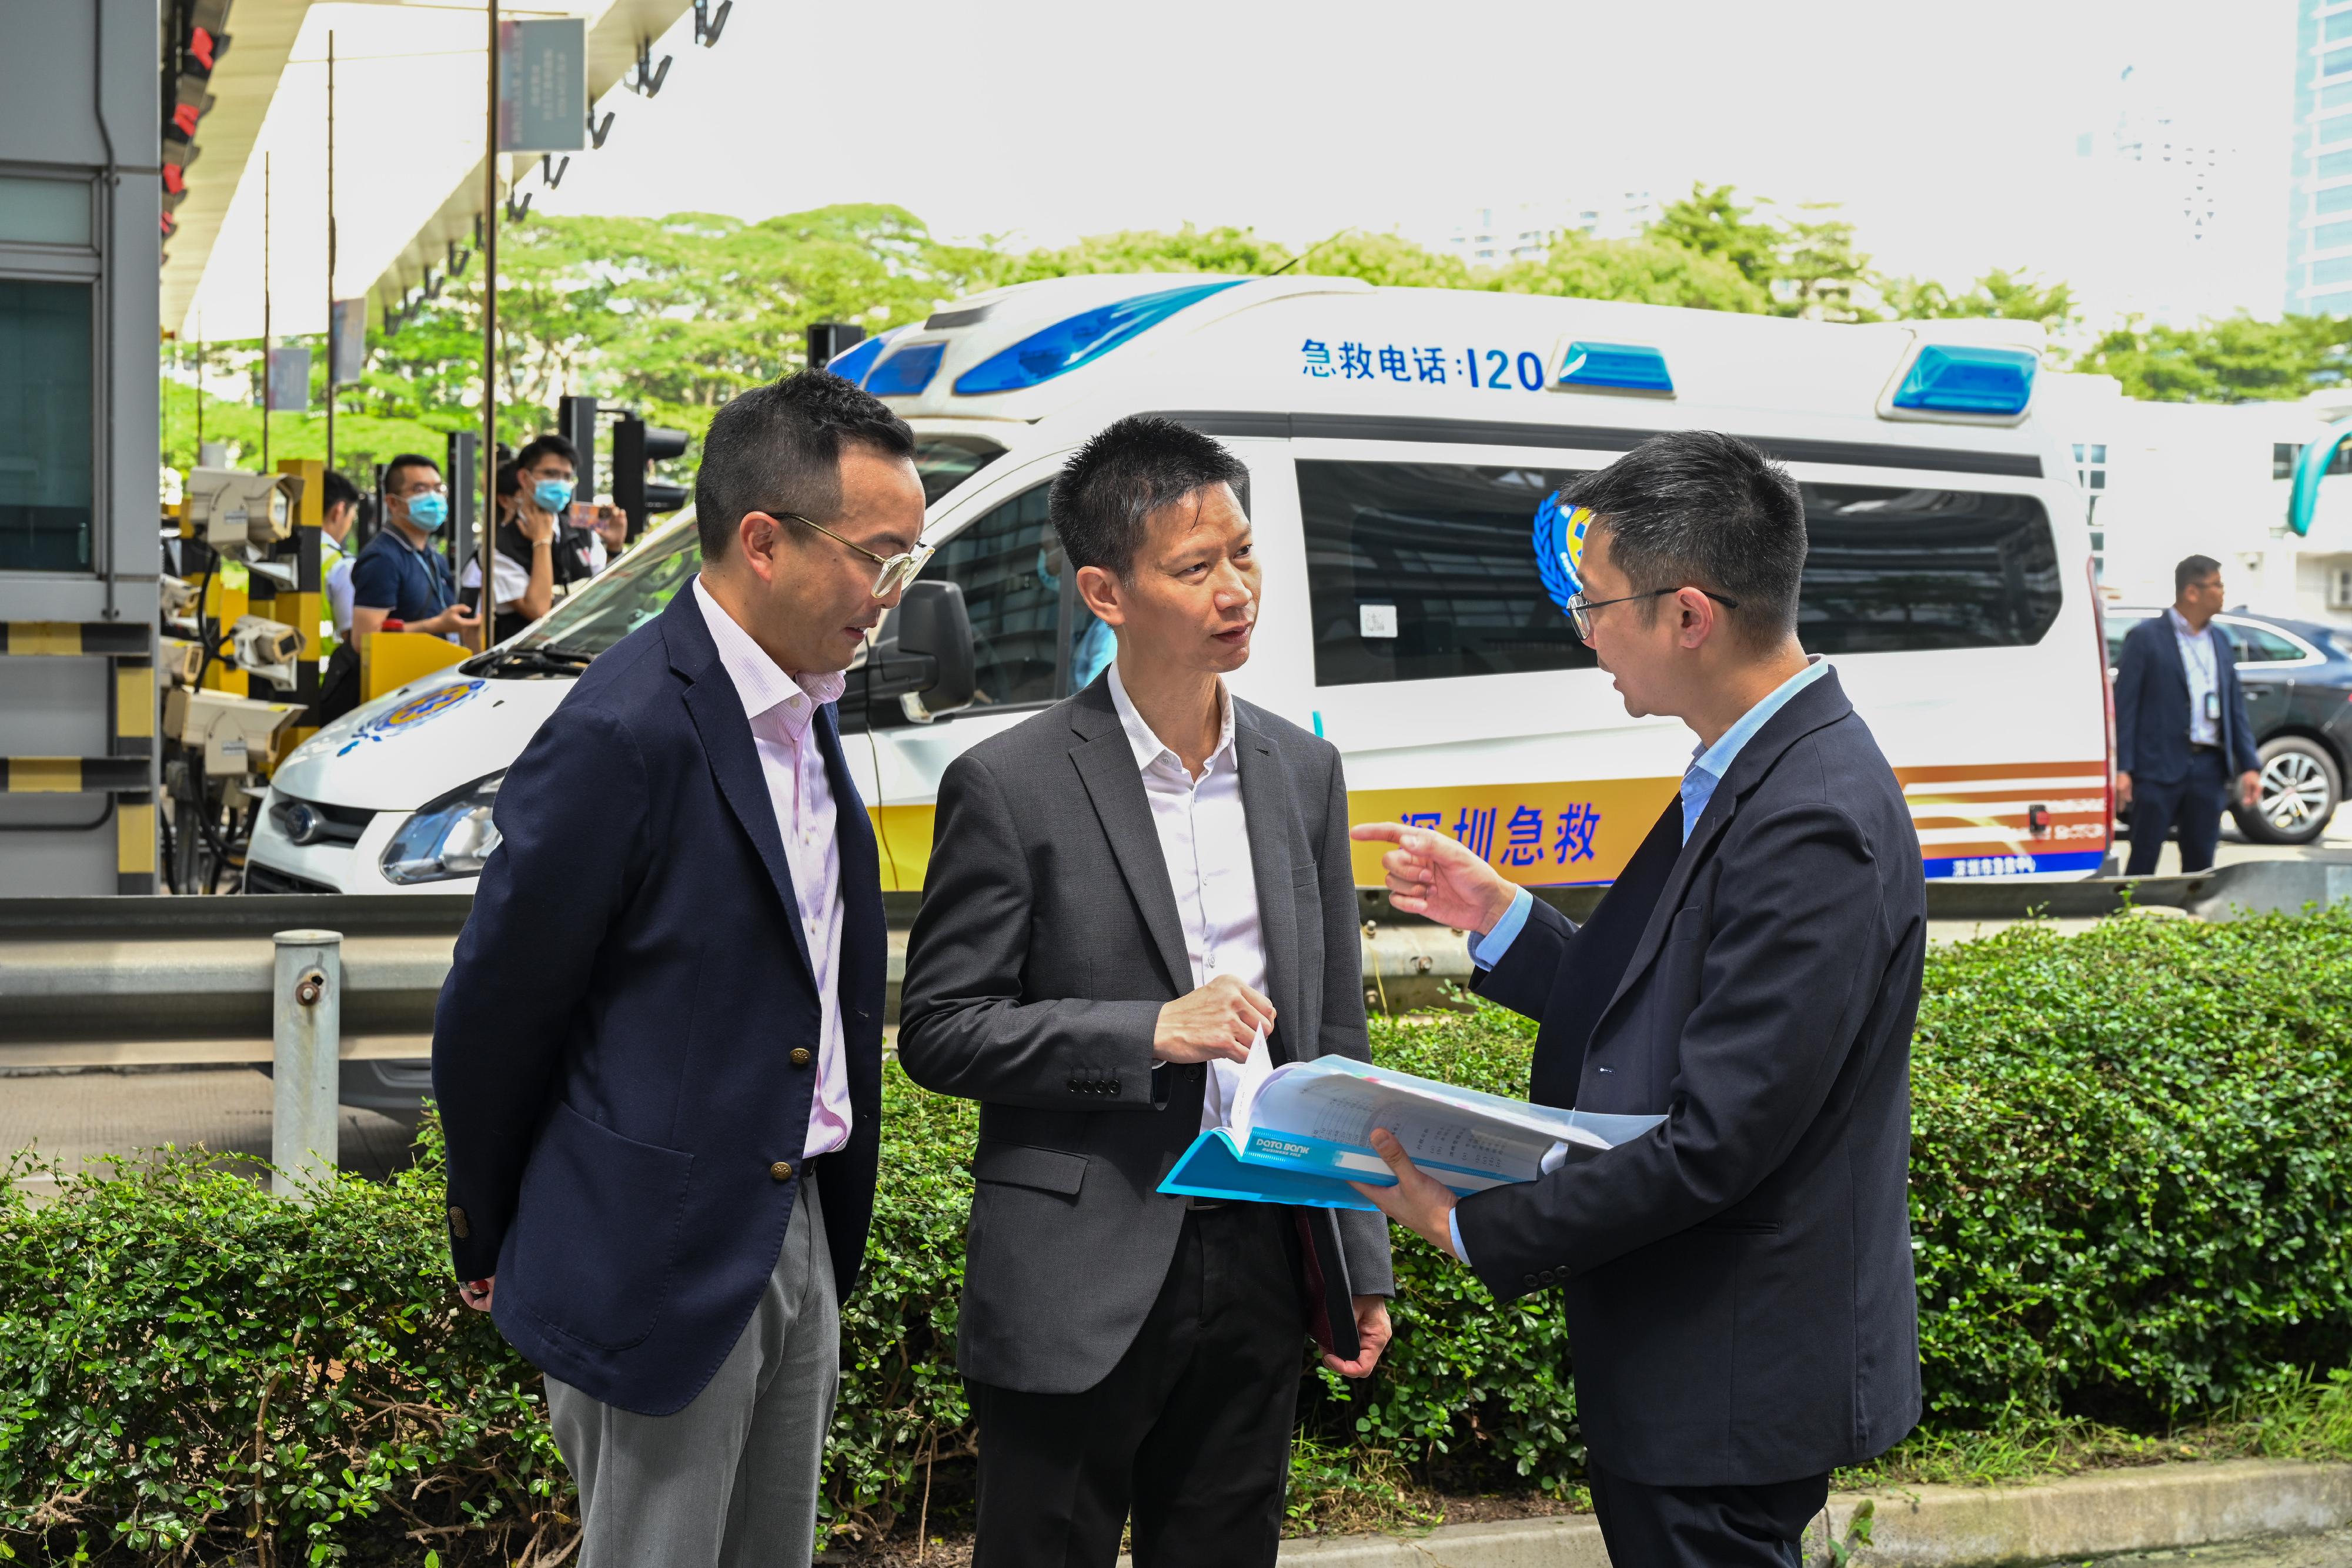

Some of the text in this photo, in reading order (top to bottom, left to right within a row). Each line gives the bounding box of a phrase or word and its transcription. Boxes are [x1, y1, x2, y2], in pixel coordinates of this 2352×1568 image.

[1301, 339, 1544, 392] 急救电话:120
[1262, 1147, 1289, 1155] BUSINESS
